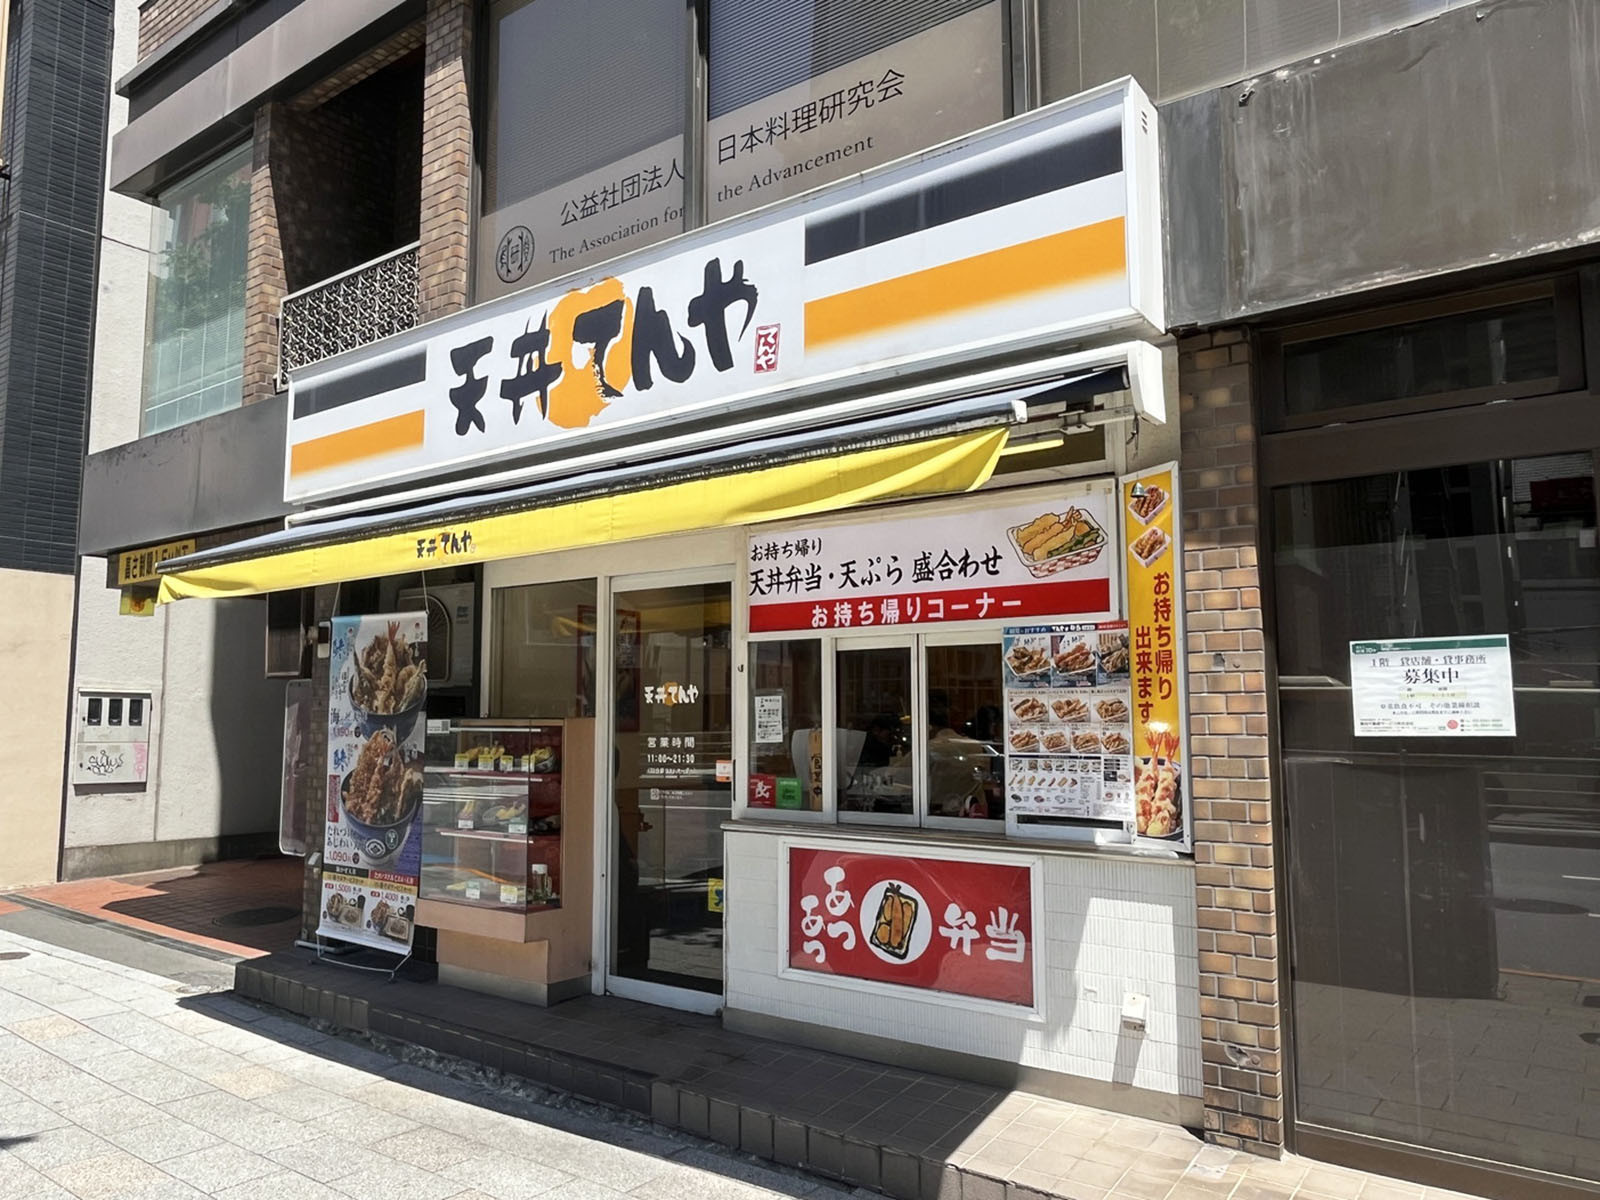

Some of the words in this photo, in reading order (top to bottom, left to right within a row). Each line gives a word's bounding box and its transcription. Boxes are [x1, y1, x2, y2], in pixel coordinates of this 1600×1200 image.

[560, 158, 685, 226] 公益社団法人
[718, 69, 905, 165] 日本料理研究会
[549, 247, 575, 263] The
[578, 217, 659, 253] Association
[717, 185, 743, 202] the
[749, 136, 874, 191] Advancement
[449, 257, 759, 436] 天丼てんや
[750, 537, 822, 561] お持ち帰り
[912, 545, 1003, 583] 盛合わせ
[810, 592, 1021, 628] お持ち帰りコーナー
[1153, 571, 1174, 700] お持ち帰り
[1135, 625, 1154, 724] 出来ます
[1404, 667, 1460, 684] 募集中
[647, 736, 695, 748] 営業時間
[938, 903, 1026, 963] 弁当
